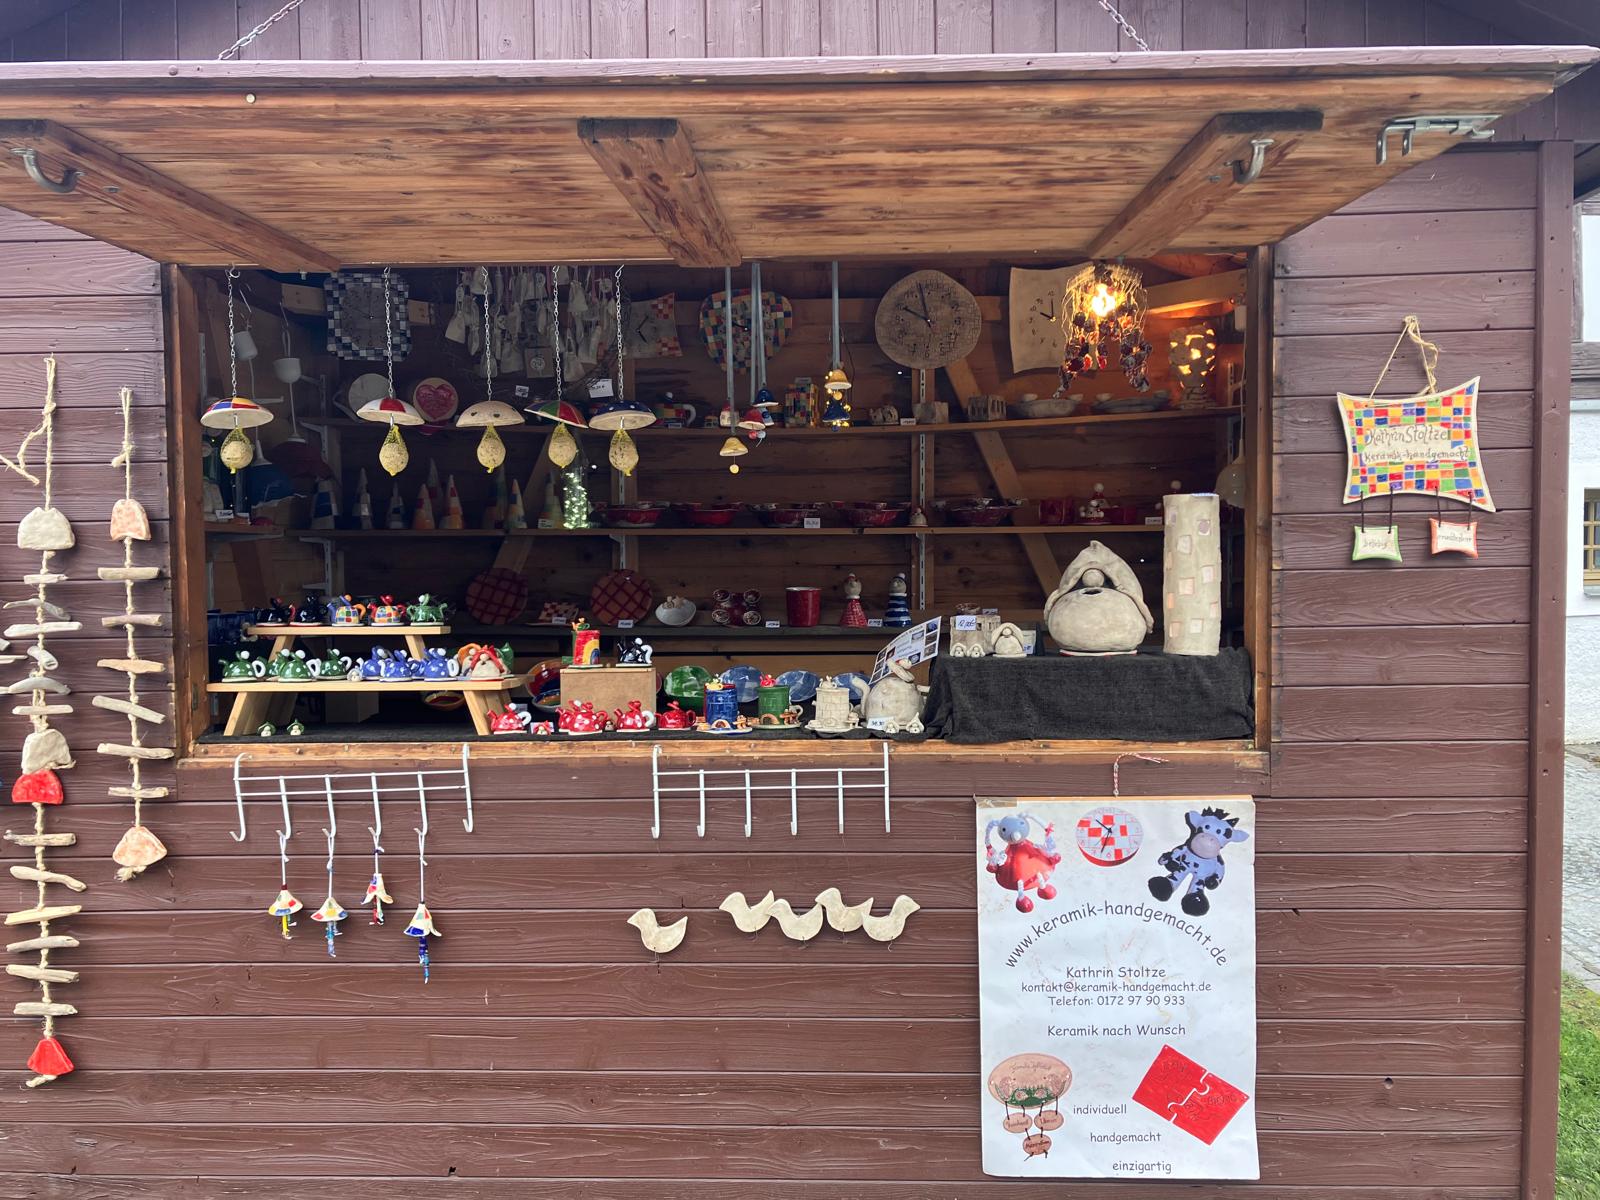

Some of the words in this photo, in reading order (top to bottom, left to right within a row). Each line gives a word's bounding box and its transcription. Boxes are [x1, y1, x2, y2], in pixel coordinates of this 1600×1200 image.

[1406, 424, 1447, 444] Stoltze
[1006, 901, 1228, 968] www.keramik-handgemacht.de
[1066, 966, 1114, 978] Kathrin
[1118, 966, 1167, 978] Stoltze
[1021, 981, 1212, 995] kontakt@keramik-handgemacht.de
[1048, 995, 1094, 1006] Telefon:
[1096, 995, 1125, 1006] 0172
[1127, 995, 1142, 1006] 97
[1145, 995, 1161, 1006] 90
[1164, 995, 1186, 1006] 933
[1047, 1025, 1099, 1036] Keramik
[1102, 1025, 1132, 1036] nach
[1136, 1024, 1187, 1036] Wunsch
[1072, 1104, 1127, 1115] individuell
[1089, 1131, 1162, 1144] handgemacht
[1112, 1160, 1172, 1175] einzigartig
